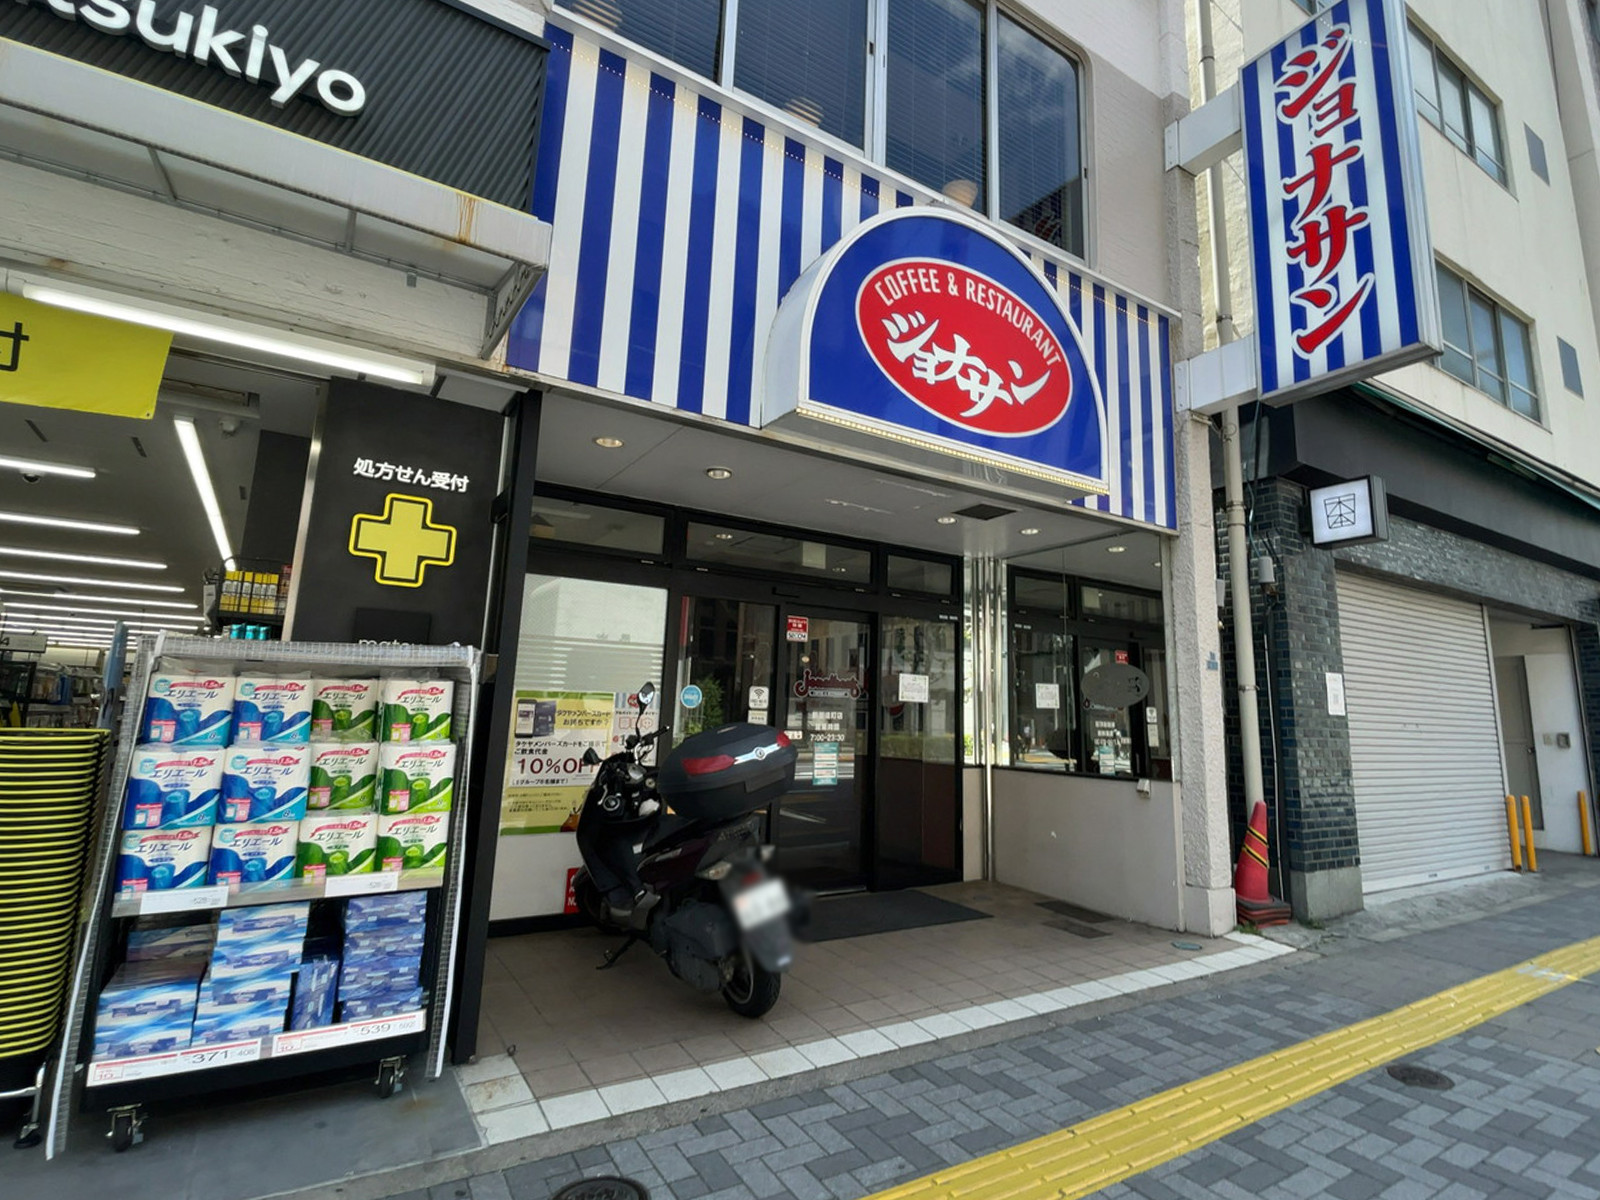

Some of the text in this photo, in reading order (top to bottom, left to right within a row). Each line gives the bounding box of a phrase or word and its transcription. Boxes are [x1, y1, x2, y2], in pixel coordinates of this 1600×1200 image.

[1276, 24, 1374, 357] ジョナサン
[874, 268, 1062, 367] COFFEE & RESTAURANT
[880, 310, 1052, 418] ジョナサン
[353, 457, 470, 493] 処方せん受付
[163, 690, 219, 700] エリエール
[249, 692, 299, 701] エリエール
[322, 692, 366, 700] エリエール
[401, 696, 442, 704] エリエール
[318, 757, 367, 766] エリエール
[400, 760, 445, 769] エリエール
[518, 758, 599, 774] 10%OF
[148, 768, 208, 779] エリエール
[239, 766, 294, 776] エリエール
[391, 825, 438, 835] エリエール
[314, 831, 364, 841] エリエール
[134, 842, 193, 853] エリエール
[231, 838, 283, 848] エリエール
[360, 1023, 391, 1036] 539
[192, 1050, 229, 1064] 371
